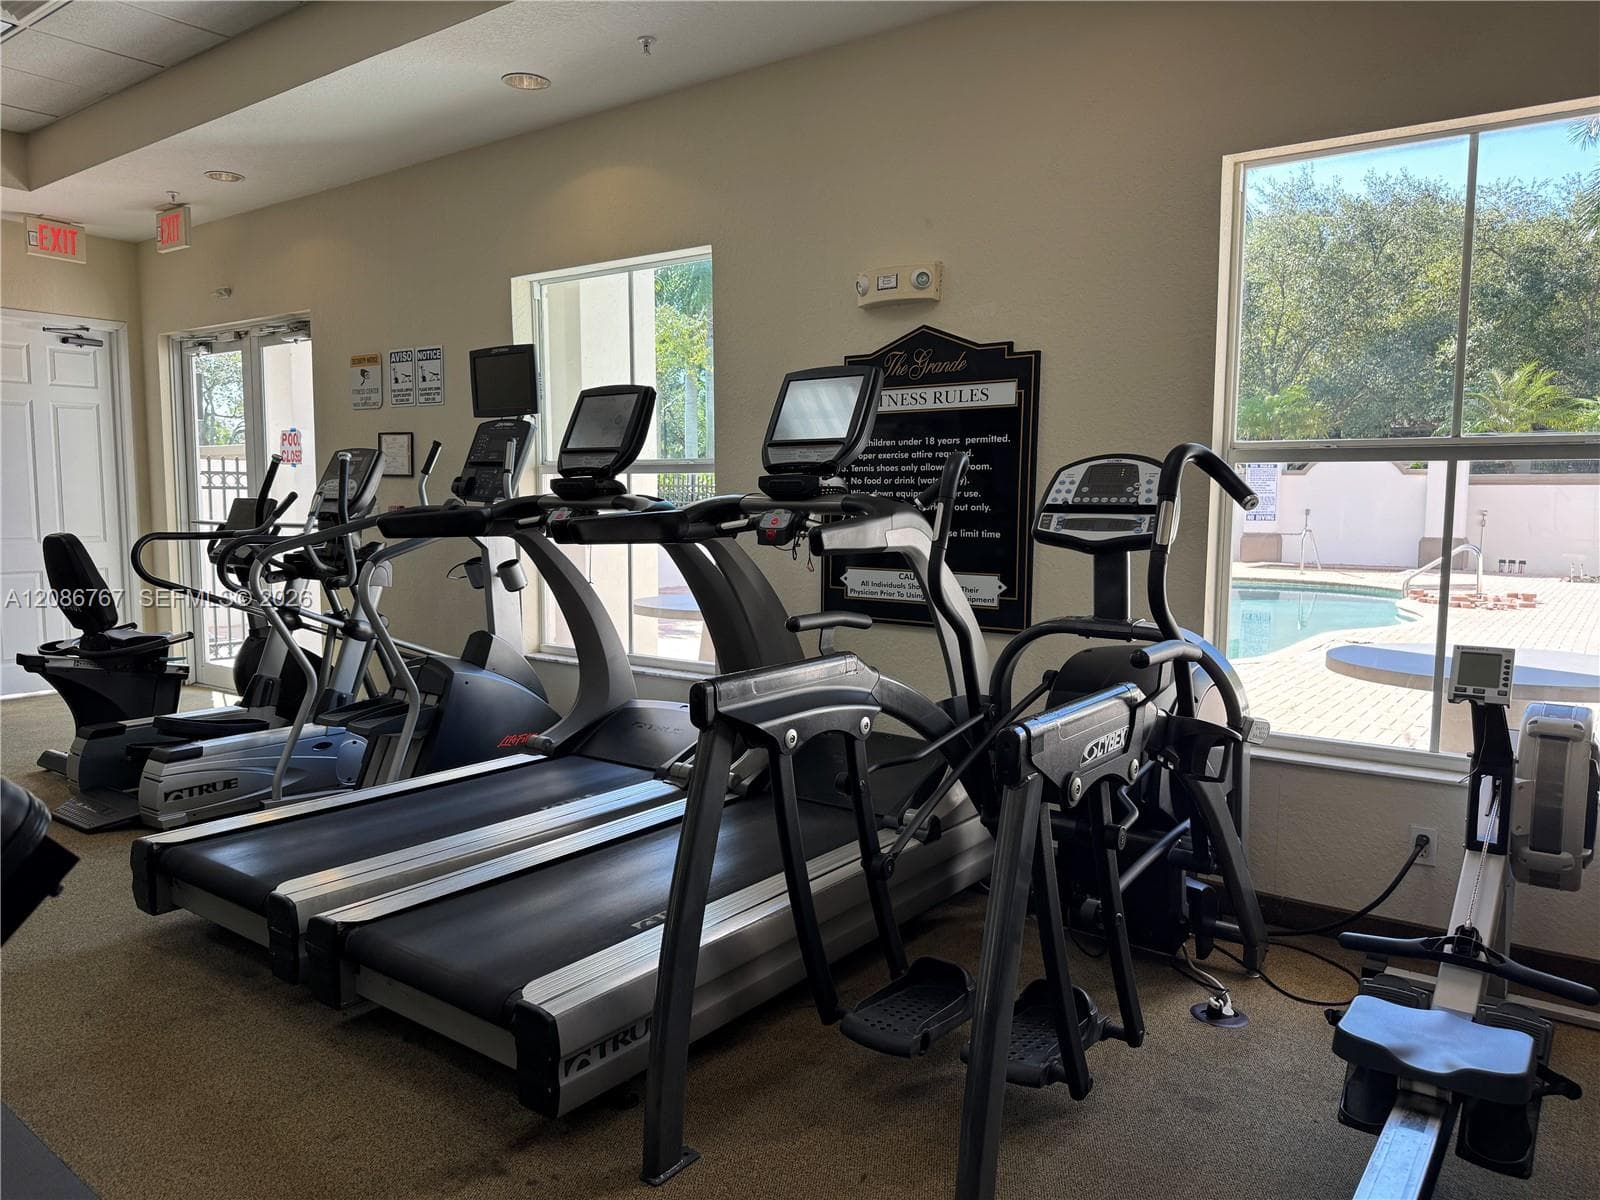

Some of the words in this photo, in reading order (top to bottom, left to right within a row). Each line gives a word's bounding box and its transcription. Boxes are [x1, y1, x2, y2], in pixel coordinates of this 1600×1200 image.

[160, 213, 181, 246] EXIT
[38, 223, 78, 256] EXIT
[391, 351, 412, 363] AVISO
[417, 349, 441, 361] NOTICE
[884, 351, 909, 378] The
[909, 348, 967, 380] Grande
[880, 391, 927, 407] TNESS
[933, 387, 989, 404] RULES
[867, 438, 896, 447] hildren
[898, 437, 922, 446] under
[925, 437, 935, 445] 18
[937, 438, 960, 447] years
[965, 434, 1011, 446] permitted.
[858, 453, 876, 461] oper
[878, 451, 909, 459] exercise
[911, 450, 933, 459] attire
[851, 464, 874, 472] Tennis
[876, 463, 899, 472] shoes
[901, 463, 918, 473] only
[920, 462, 944, 471] allow
[851, 477, 862, 485] No
[864, 476, 882, 485] food
[894, 476, 915, 485] drink
[918, 476, 939, 486] (wat
[896, 489, 922, 499] equip
[970, 503, 991, 513] only.
[960, 529, 979, 538] limit
[981, 529, 1001, 539] time
[871, 580, 906, 590] Individuals
[850, 588, 879, 597] Physician
[880, 590, 896, 598] Prior
[967, 596, 995, 604] ipment
[1097, 725, 1130, 757] CYBEX
[183, 777, 239, 798] TRUE
[594, 1015, 652, 1059] TRU
